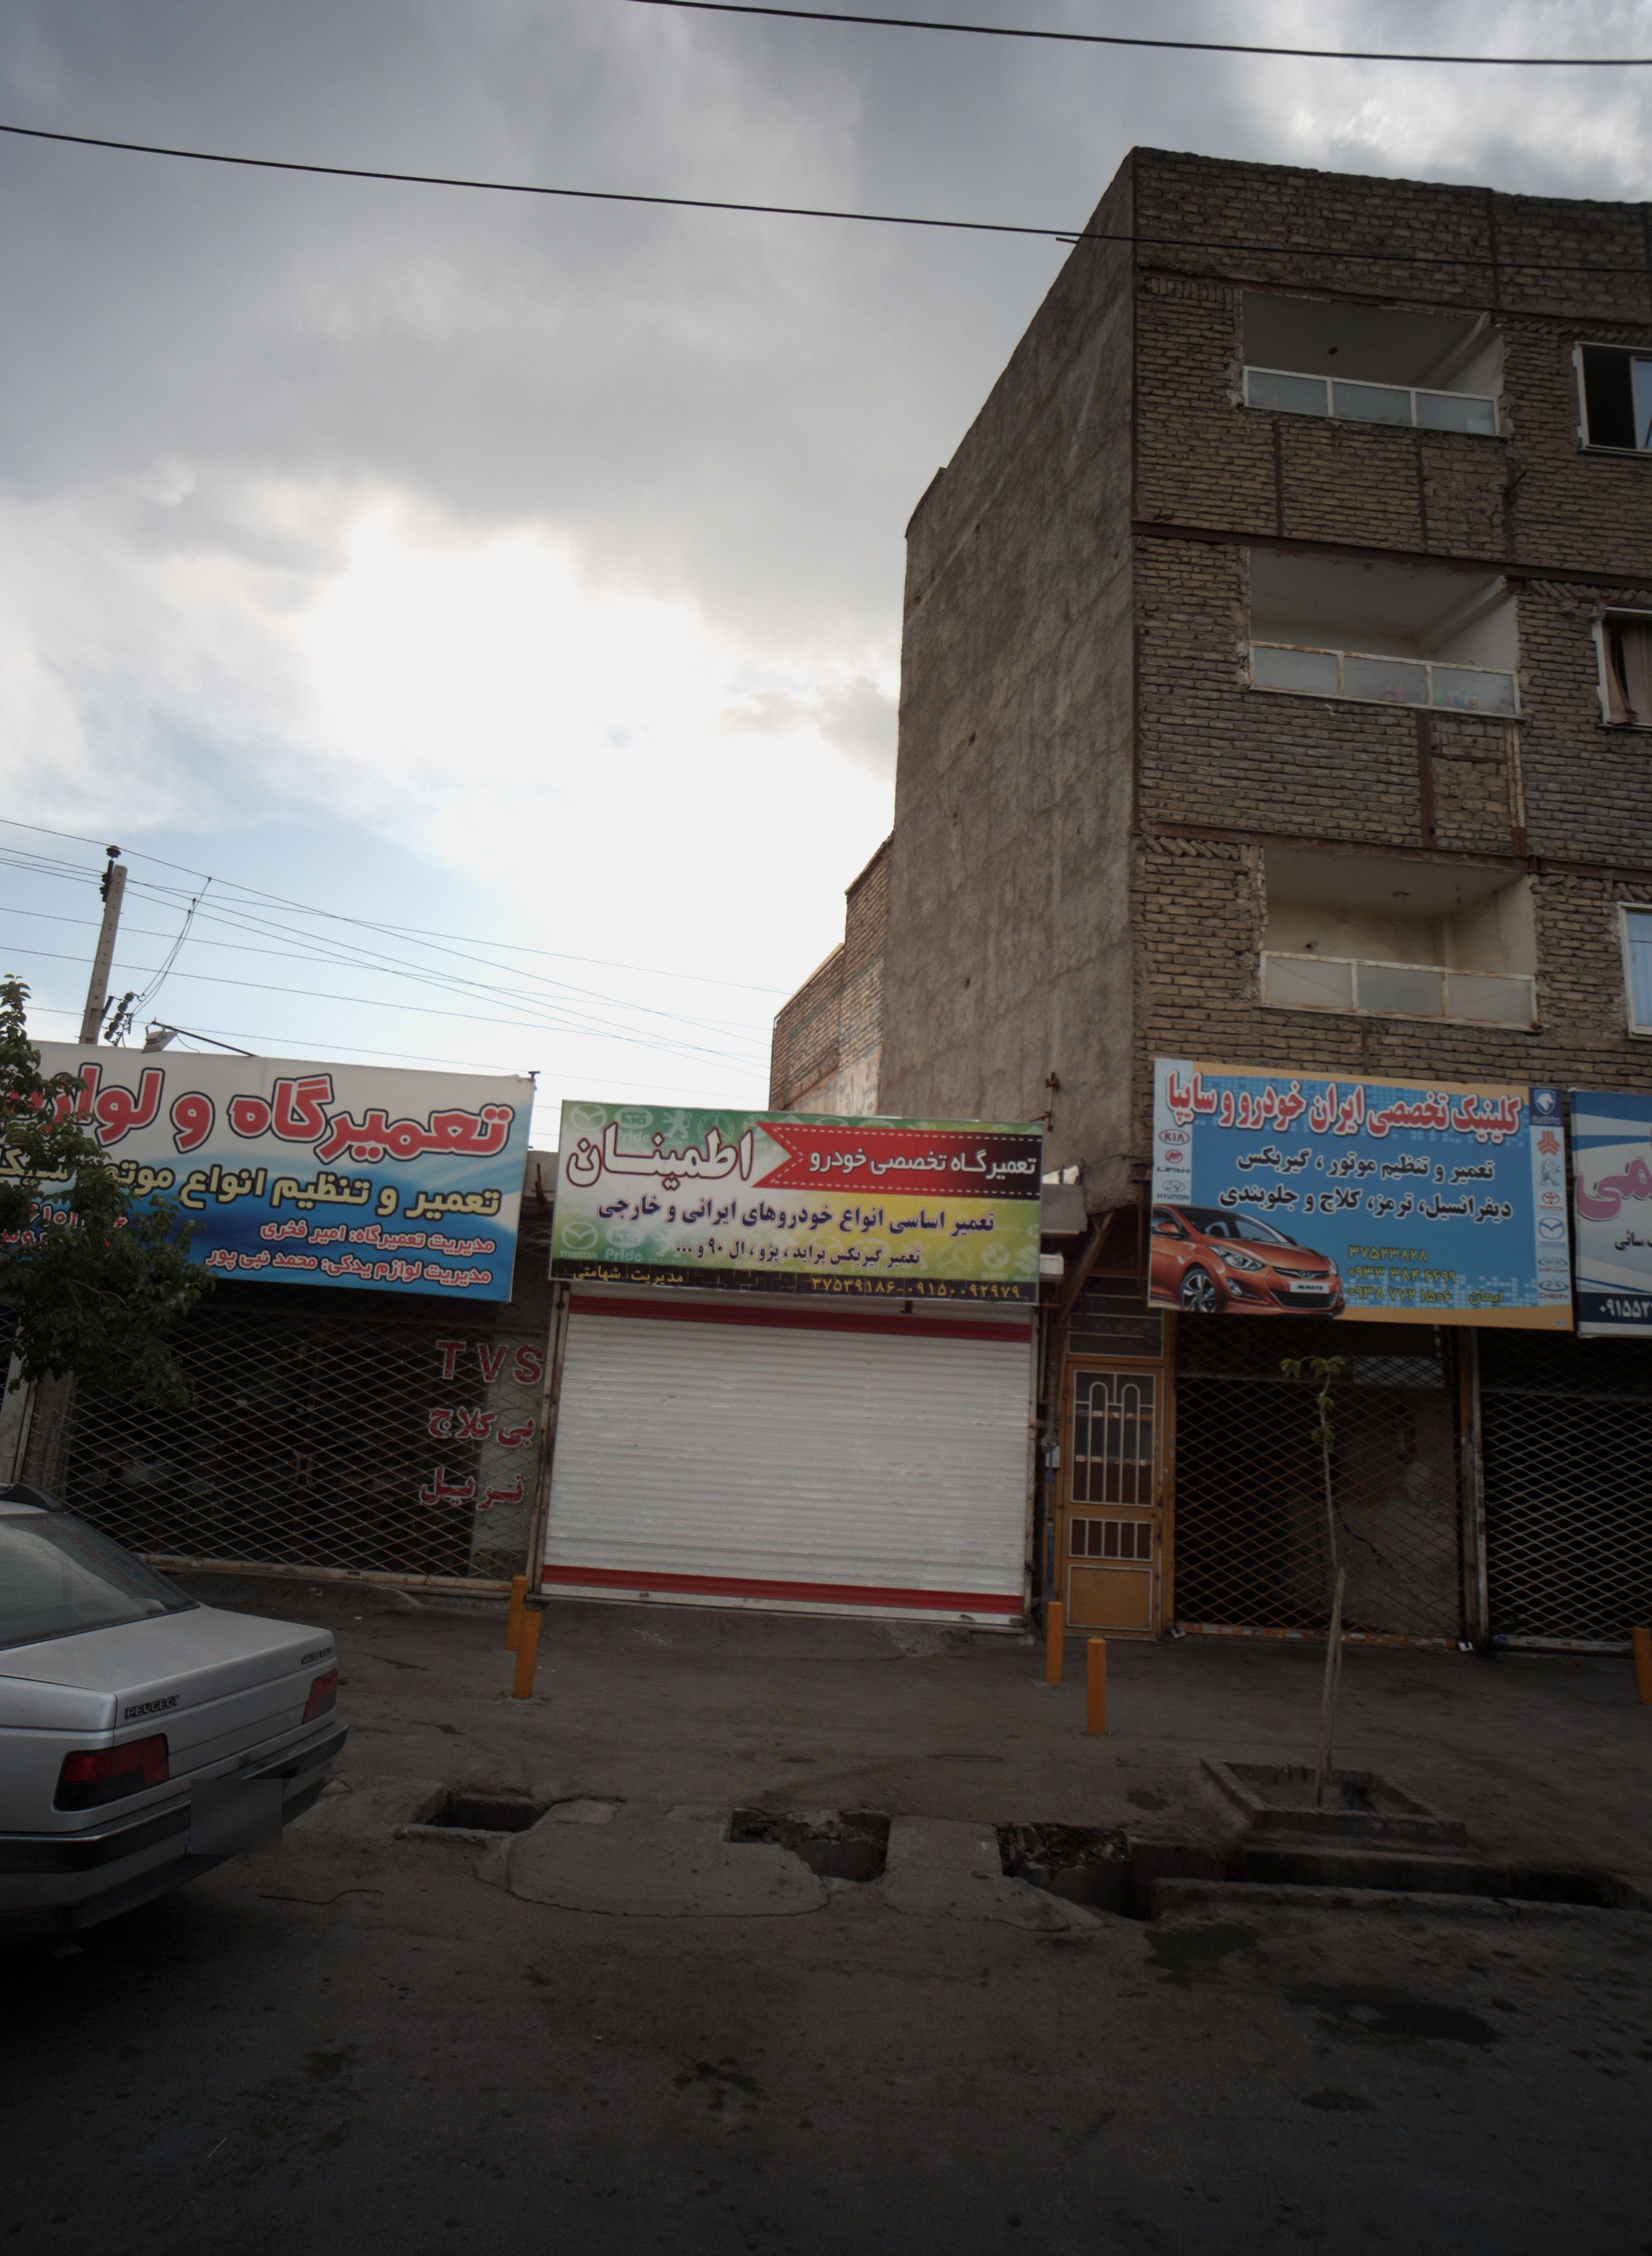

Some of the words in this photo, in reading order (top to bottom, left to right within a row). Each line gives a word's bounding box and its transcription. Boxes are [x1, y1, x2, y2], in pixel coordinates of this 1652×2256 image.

[1167, 1070, 1217, 1126] سایپا
[1218, 1091, 1235, 1126] و
[1236, 1080, 1307, 1131] خودرو
[1308, 1083, 1365, 1136] ایران
[170, 1091, 215, 1154] و
[227, 1073, 515, 1164] تعمیرگاه
[1366, 1091, 1449, 1137] تخصصی
[1451, 1093, 1521, 1144] کلینیک
[1165, 1132, 1184, 1143] KIA
[566, 1121, 753, 1190] اطمینان
[809, 1147, 867, 1173] خودرو
[871, 1150, 947, 1175] تخصصی
[1237, 1145, 1311, 1173] گیربکس
[1327, 1151, 1377, 1178] موتور
[1381, 1154, 1430, 1180] تنظیم
[1434, 1164, 1445, 1183] و
[1448, 1161, 1495, 1184] تعمیر
[178, 1163, 268, 1210] انواع
[269, 1170, 372, 1211] تنظیم
[1220, 1184, 1300, 1211] جلوبندی
[375, 1186, 399, 1217] و
[404, 1189, 502, 1219] تعمیر
[597, 1194, 661, 1221] خارجی
[666, 1204, 676, 1223] و
[682, 1197, 737, 1226] ایرانی
[1303, 1194, 1314, 1212] و
[1320, 1189, 1362, 1213] کلاچ
[742, 1200, 834, 1232] خودروهای
[839, 1206, 885, 1234] انواع
[889, 1208, 945, 1235] اساسی
[950, 1212, 995, 1237] تعمیر
[260, 1219, 307, 1240] فخری
[307, 1224, 347, 1244] امیر
[349, 1224, 426, 1250] تعمیرگاه:
[428, 1234, 495, 1256] مدیریت
[696, 1245, 704, 1260] و
[729, 1239, 745, 1260] ال
[758, 1242, 779, 1262] پژو
[792, 1244, 826, 1265] پراید
[830, 1246, 883, 1266] گیربکس
[204, 1247, 239, 1271] پور
[238, 1249, 271, 1270] نبی
[273, 1251, 318, 1268] محمد
[321, 1254, 371, 1277] یدکی:
[373, 1259, 423, 1283] لوازم
[886, 1249, 921, 1268] تعمیر
[423, 1262, 492, 1288] مدیریت
[573, 1266, 621, 1282] شهامتی
[1469, 1289, 1504, 1305] ایمان
[436, 1340, 544, 1385] TVS
[126, 1695, 180, 1719] PEUGEOT
